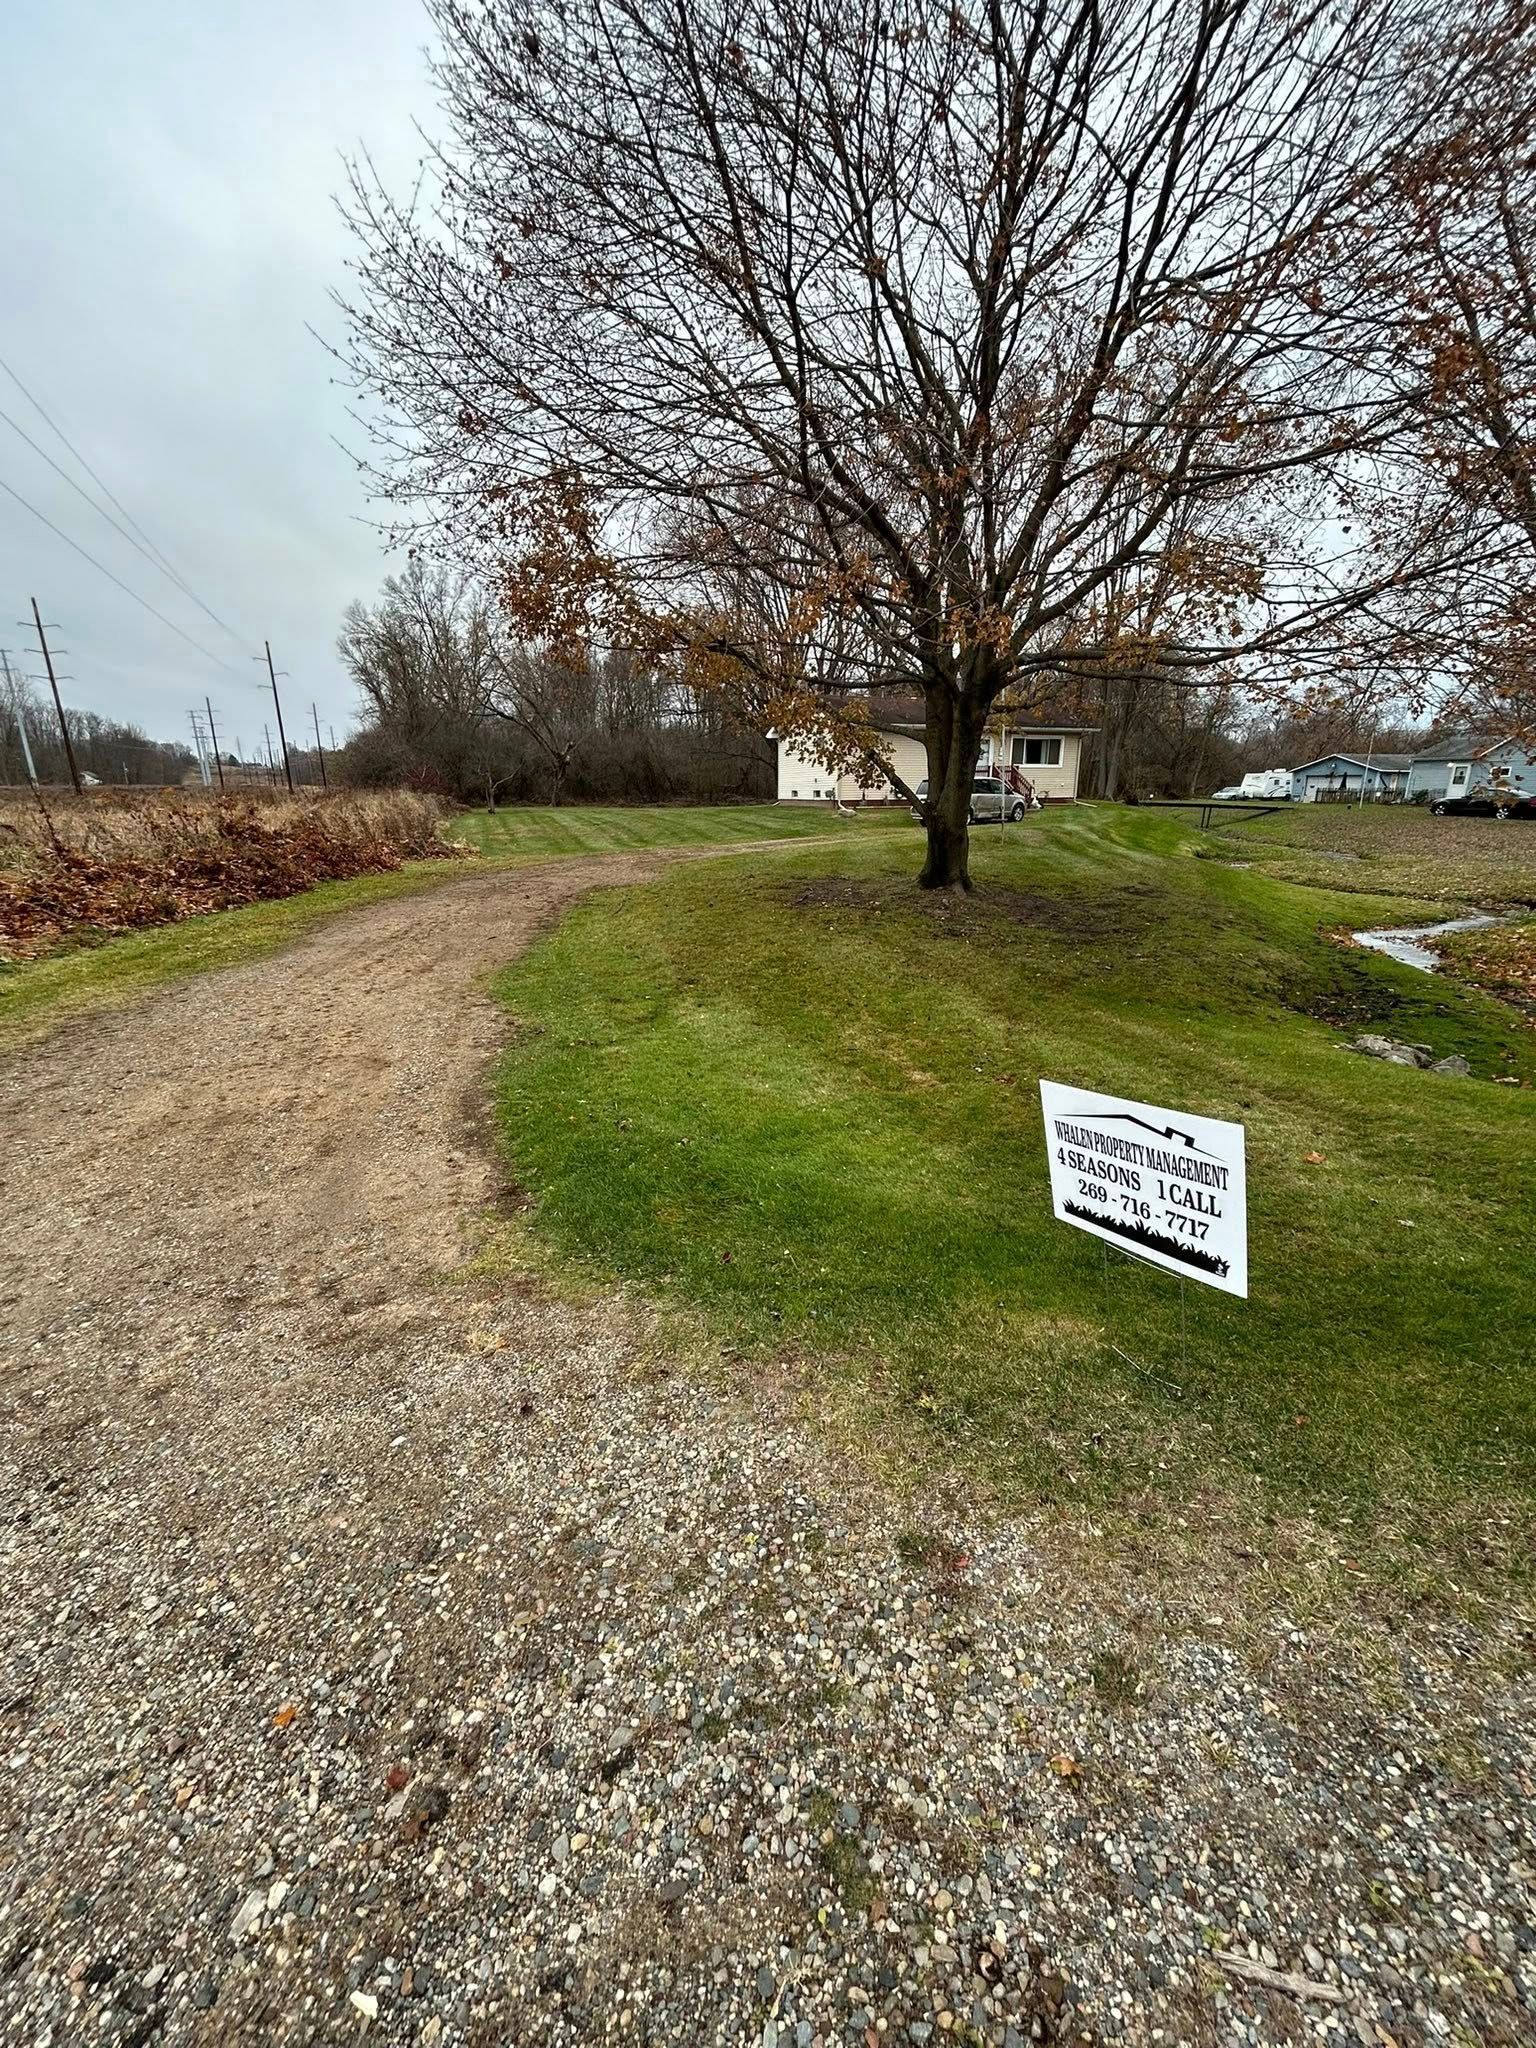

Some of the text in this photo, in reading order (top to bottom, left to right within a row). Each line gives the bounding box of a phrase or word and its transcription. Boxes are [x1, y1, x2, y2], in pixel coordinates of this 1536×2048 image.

[1055, 1120, 1228, 1190] WHALEN PROPERTY MANAGEMENT
[1058, 1148, 1221, 1218] 4 SEASONS 1 CALL
